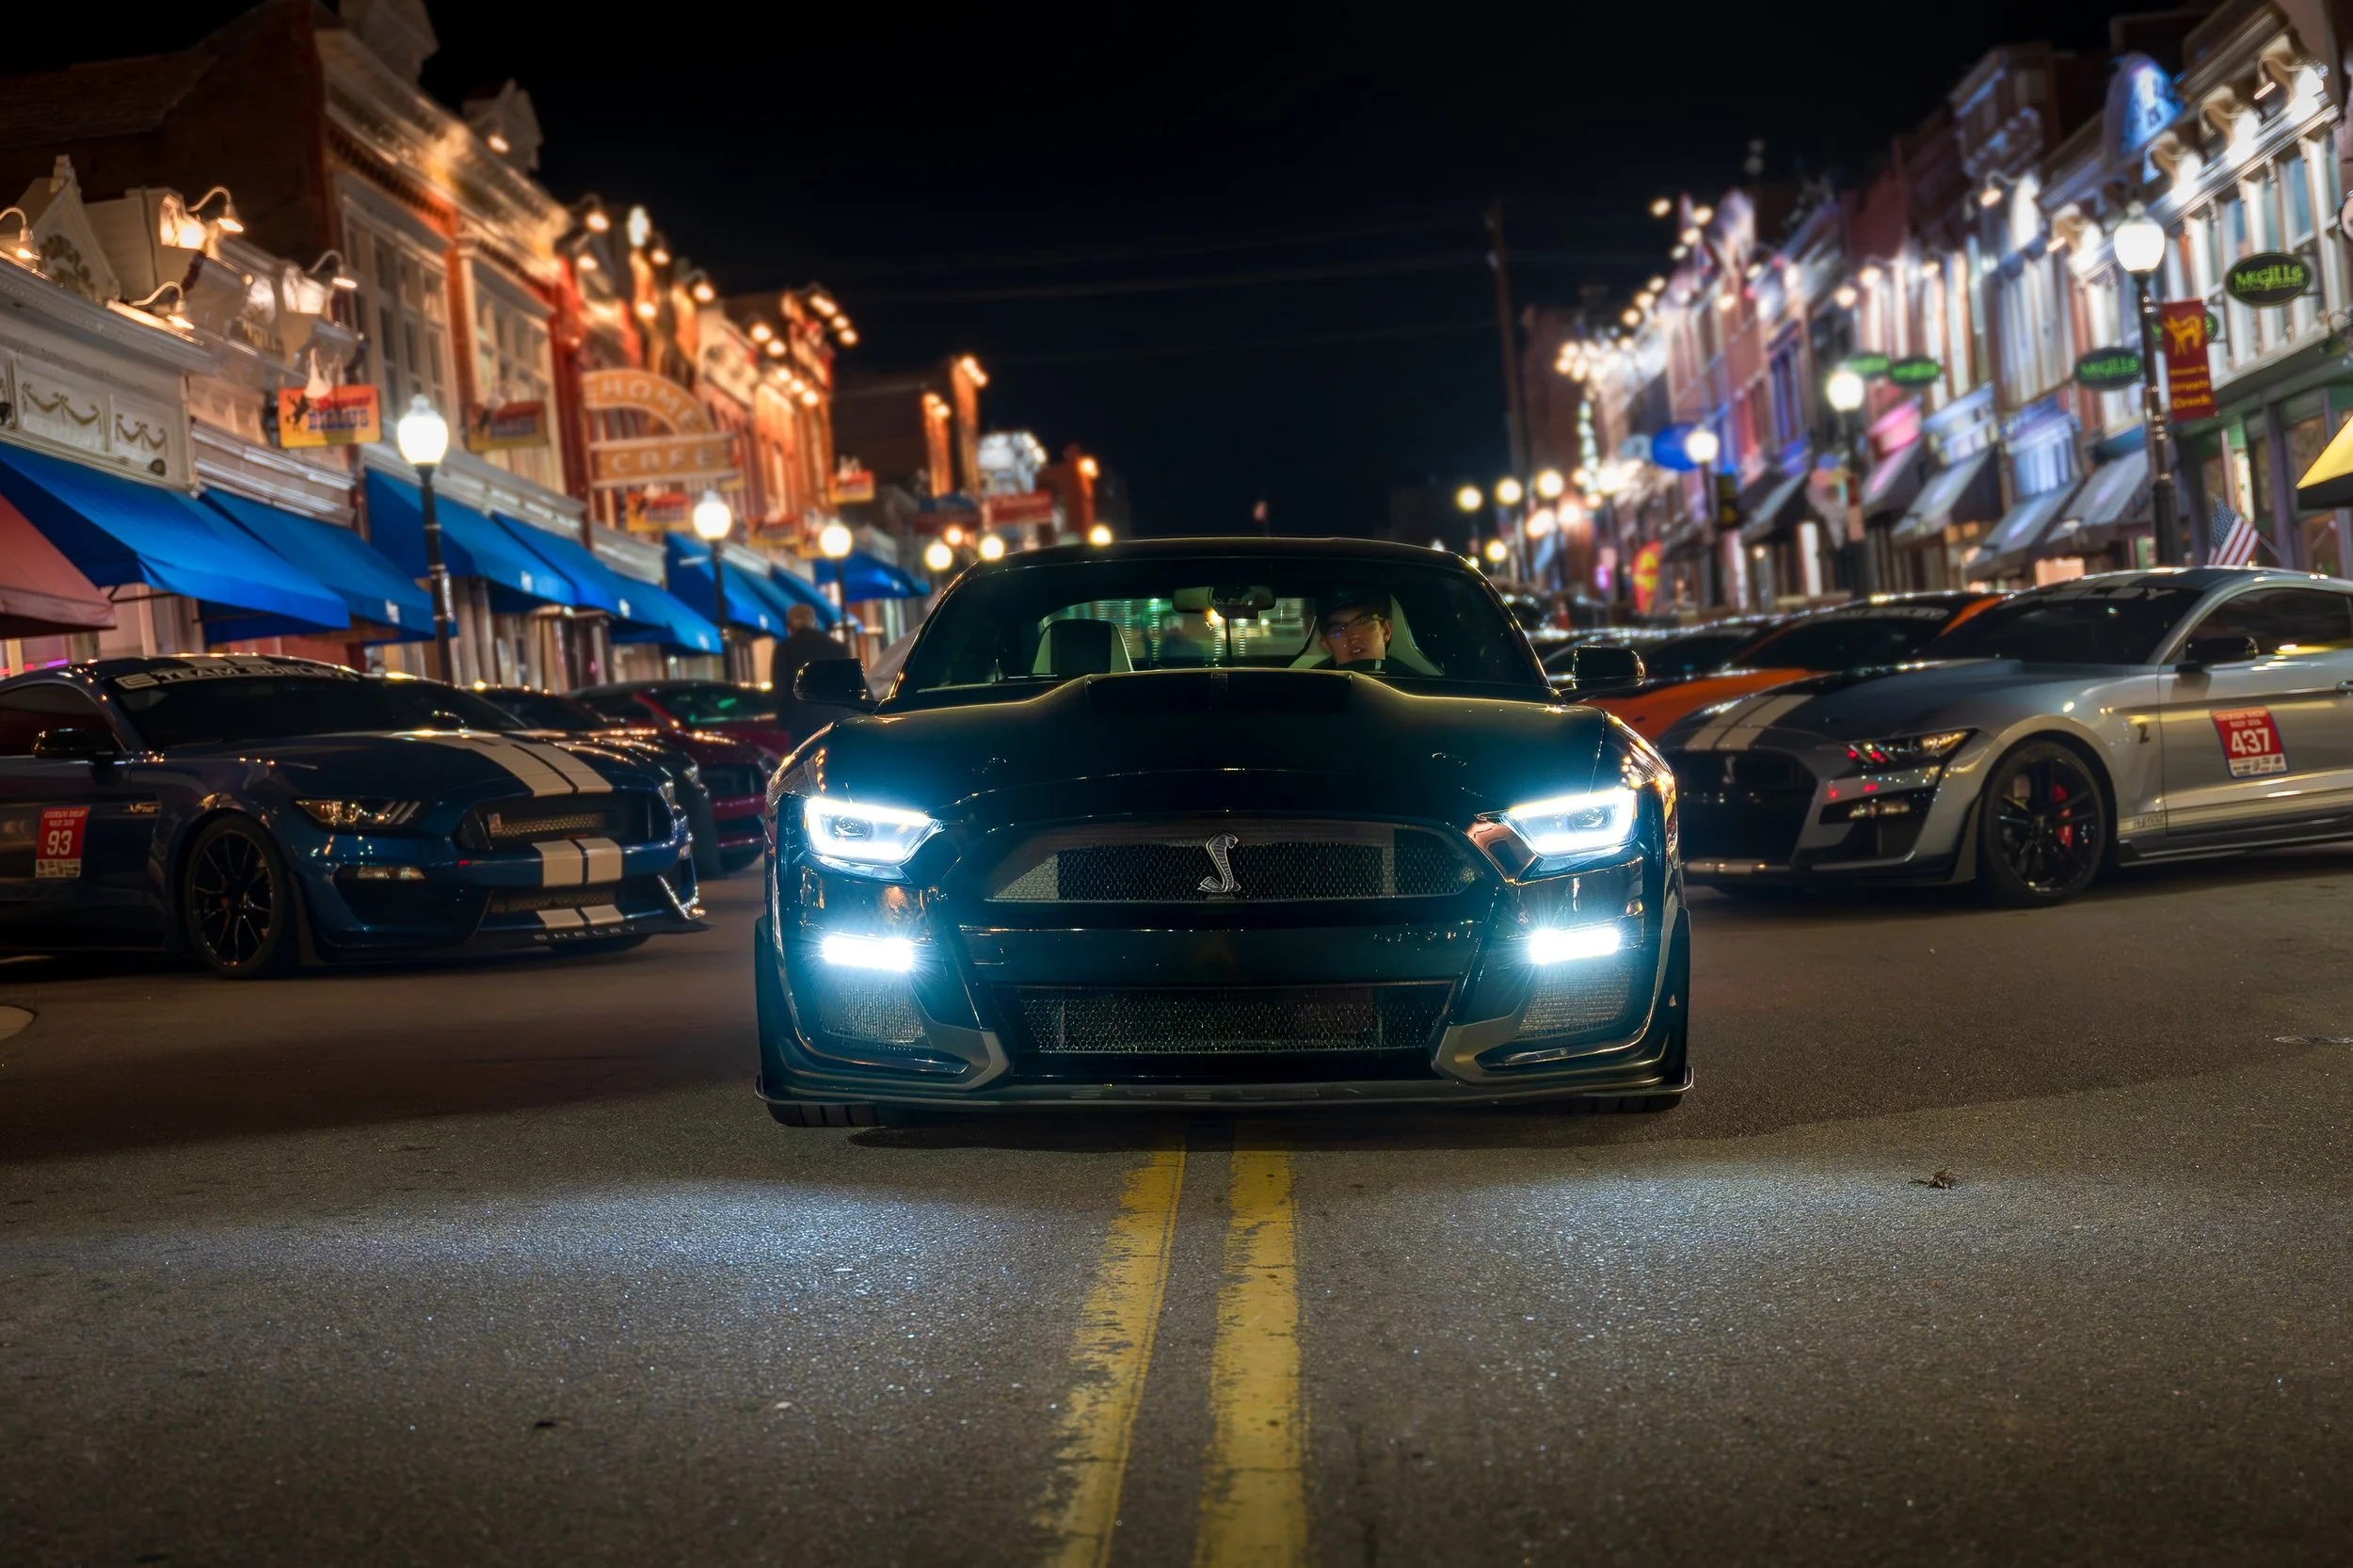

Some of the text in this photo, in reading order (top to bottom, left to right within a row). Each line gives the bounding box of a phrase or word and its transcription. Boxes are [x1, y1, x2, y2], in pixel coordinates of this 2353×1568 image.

[601, 378, 698, 424] HOME
[612, 447, 714, 472] CAFE
[159, 667, 237, 683] TEAM
[2231, 728, 2270, 755] 437
[46, 830, 72, 856] 93
